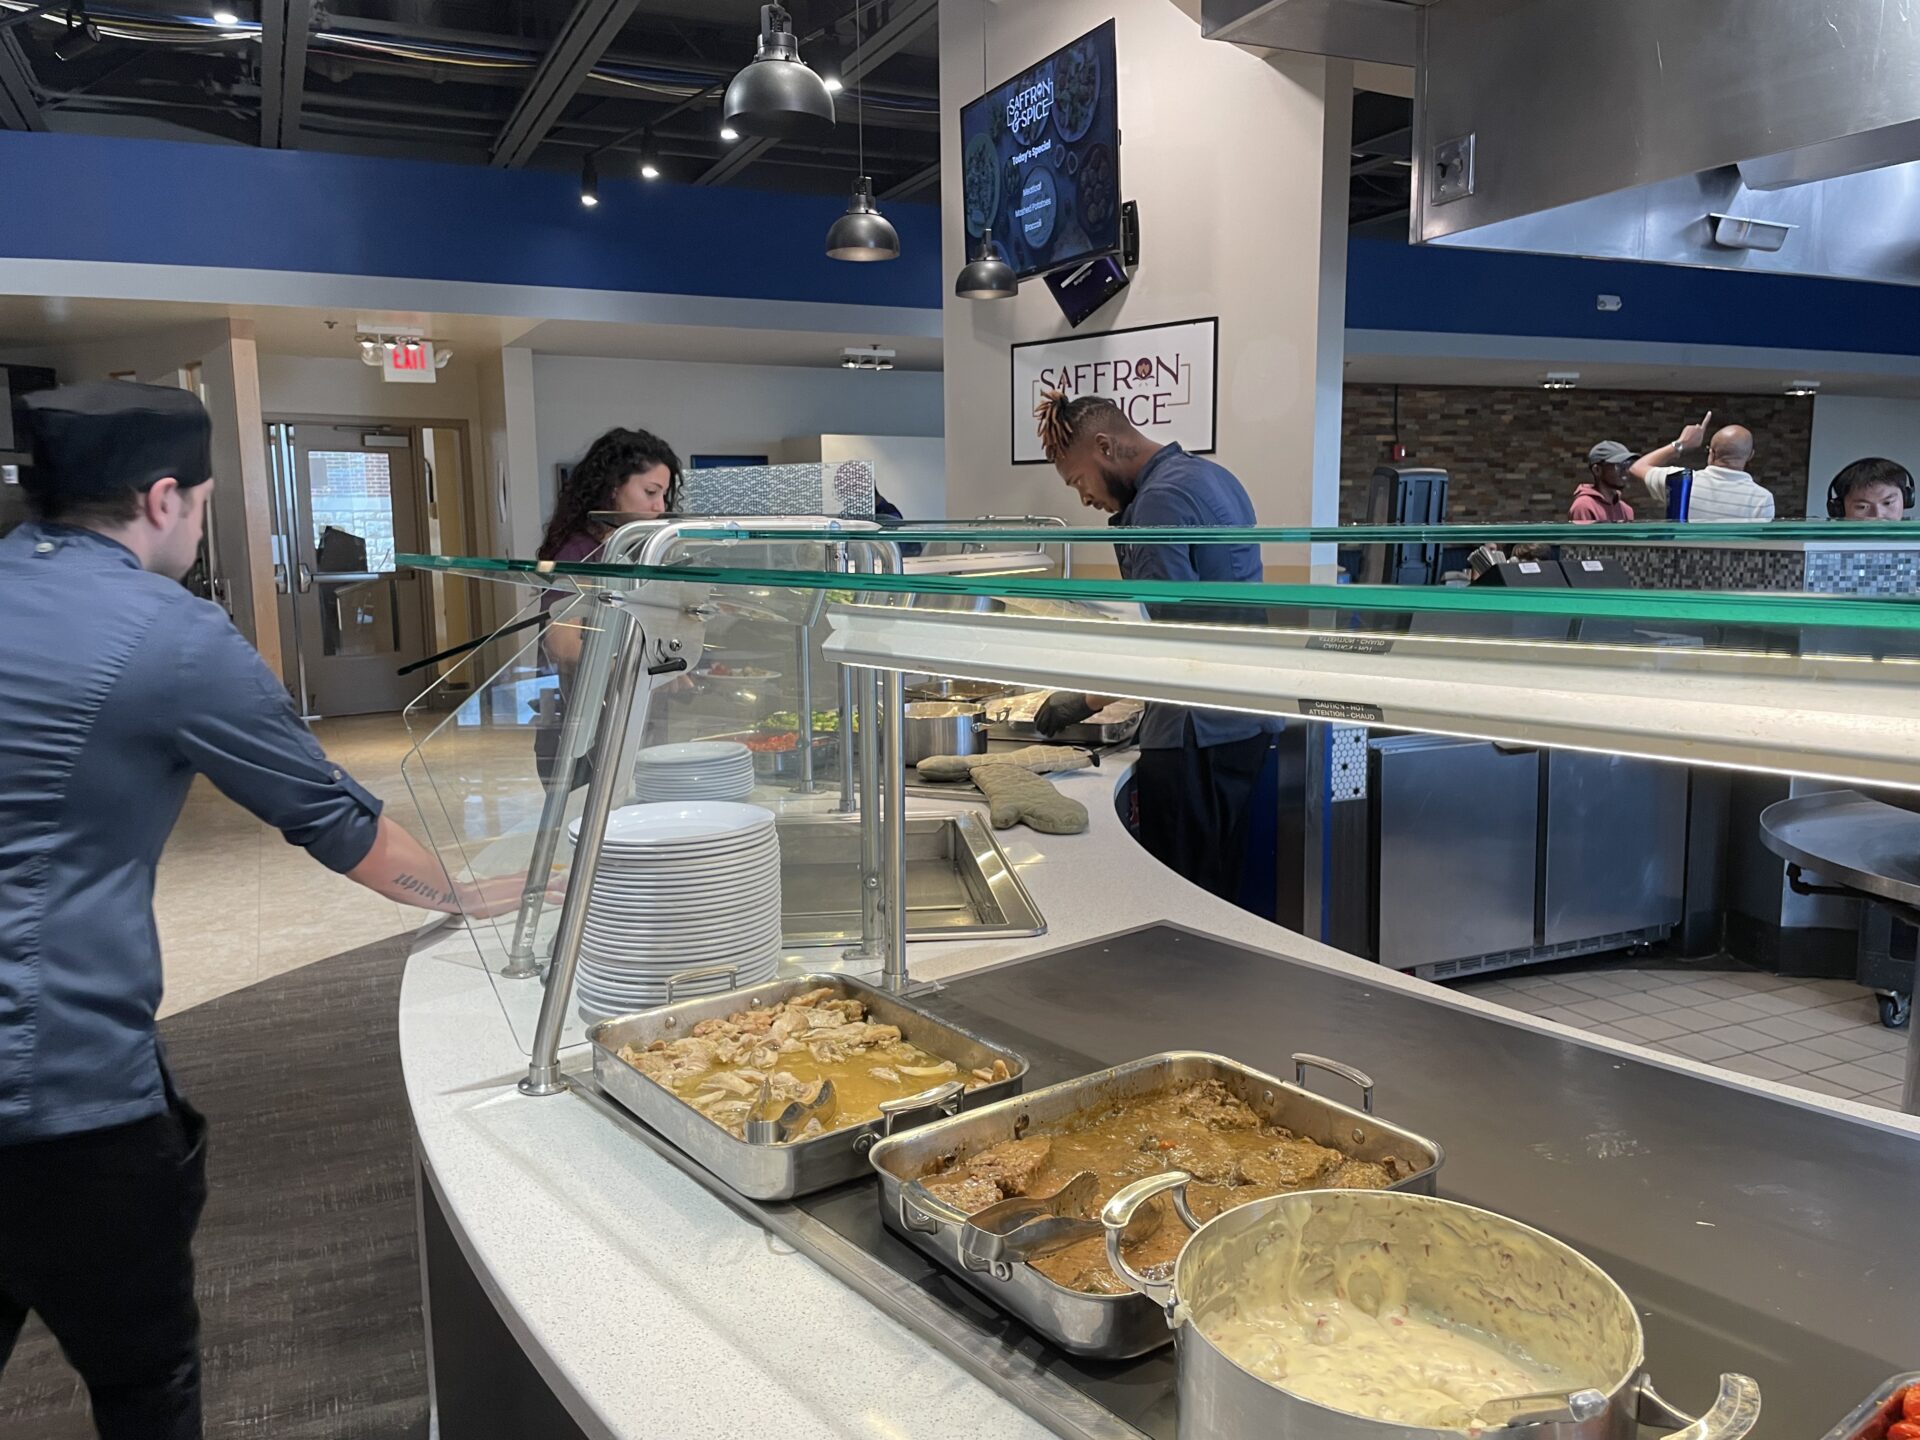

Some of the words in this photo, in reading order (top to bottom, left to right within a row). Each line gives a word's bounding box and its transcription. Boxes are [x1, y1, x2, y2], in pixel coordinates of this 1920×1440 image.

[1009, 77, 1050, 115] SAFFRON
[1011, 110, 1020, 133] &
[1021, 98, 1049, 128] SPICE
[1012, 149, 1031, 166] Today's
[1031, 138, 1051, 158] Special
[392, 343, 427, 369] EXIT
[1040, 353, 1180, 395] SAFFRON
[1309, 709, 1345, 718] ATTENTION
[1350, 712, 1375, 720] CHAUD
